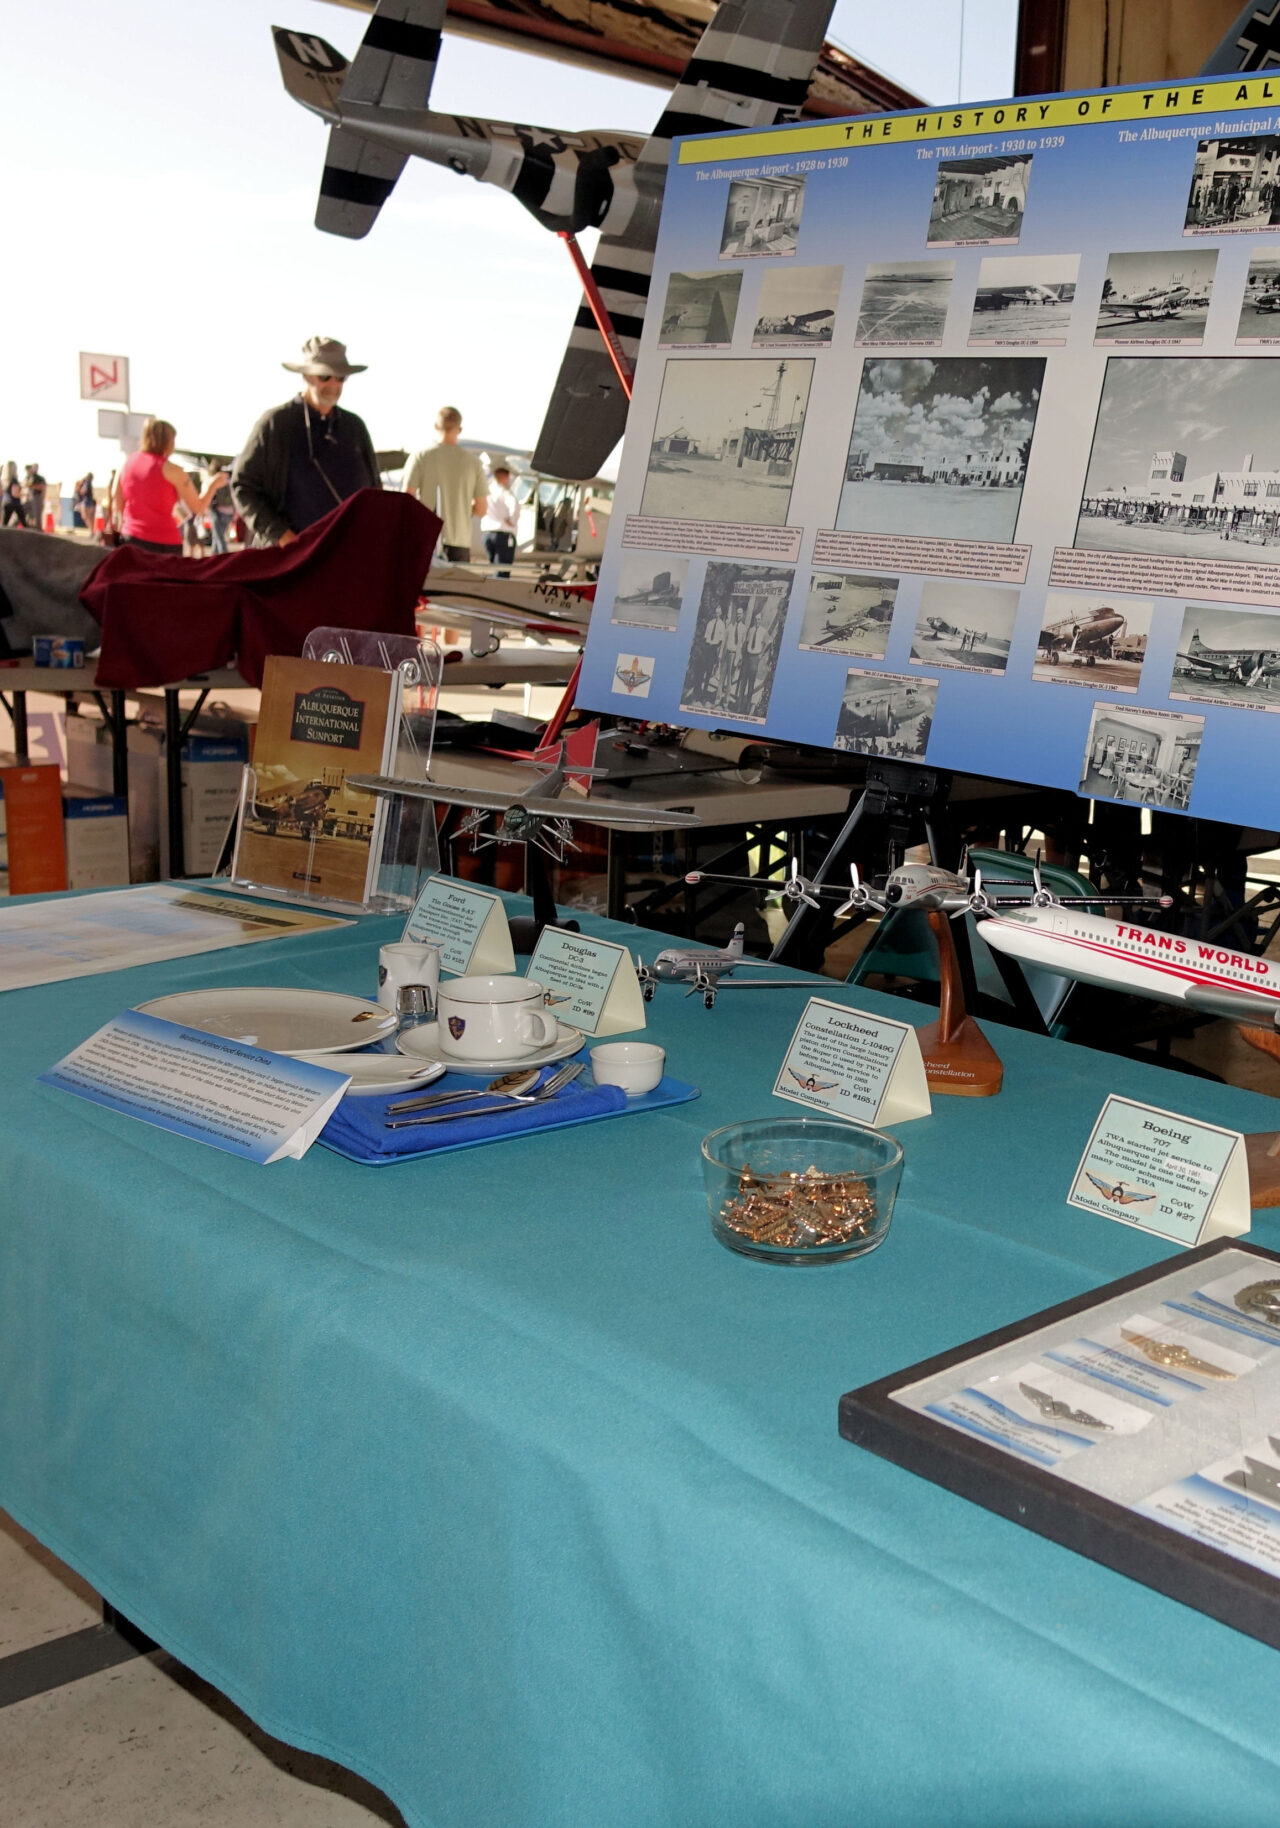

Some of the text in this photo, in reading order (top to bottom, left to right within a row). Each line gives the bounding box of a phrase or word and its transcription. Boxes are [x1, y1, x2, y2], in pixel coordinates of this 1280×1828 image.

[288, 33, 333, 67] N
[845, 122, 891, 140] THE
[916, 105, 1051, 133] HISTORY
[1077, 99, 1111, 116] OF
[1142, 89, 1203, 110] THE
[1118, 129, 1138, 142] The
[1141, 123, 1210, 143] Albuquerque
[1214, 117, 1271, 136] Municipal
[916, 135, 1064, 159] The TWA Airport 1930 to 1939
[695, 156, 848, 181] The Albuquerque Airport 1928 to 1930
[534, 584, 586, 603] NAVY
[300, 699, 359, 718] ALBUQUERQUE
[296, 712, 360, 732] INTERNATIONAL
[306, 728, 344, 744] SUNPORT
[448, 894, 465, 904] Ford
[562, 942, 597, 957] Douglas
[1115, 924, 1270, 976] TRANS WORLD
[806, 1022, 894, 1052] Constellation L-1049G
[828, 1017, 878, 1038] Lockheed
[780, 1086, 830, 1106] Model Company
[854, 1084, 871, 1093] CoW
[1142, 1121, 1191, 1144] Boeing
[1154, 1138, 1171, 1147] 707
[1098, 1139, 1150, 1159] Albuquerque
[1106, 1133, 1124, 1142] TWA
[1127, 1140, 1156, 1152] started
[1171, 1155, 1201, 1167] service
[1091, 1154, 1208, 1197] many color schemes used by
[1105, 1149, 1119, 1158] The
[1122, 1156, 1147, 1167] model
[1158, 1168, 1173, 1176] one
[1187, 1177, 1200, 1185] the
[1136, 1177, 1155, 1187] TWA
[1075, 1195, 1140, 1222] Model Company
[1160, 1205, 1195, 1222] ID #27
[1171, 1198, 1194, 1209] CoW
